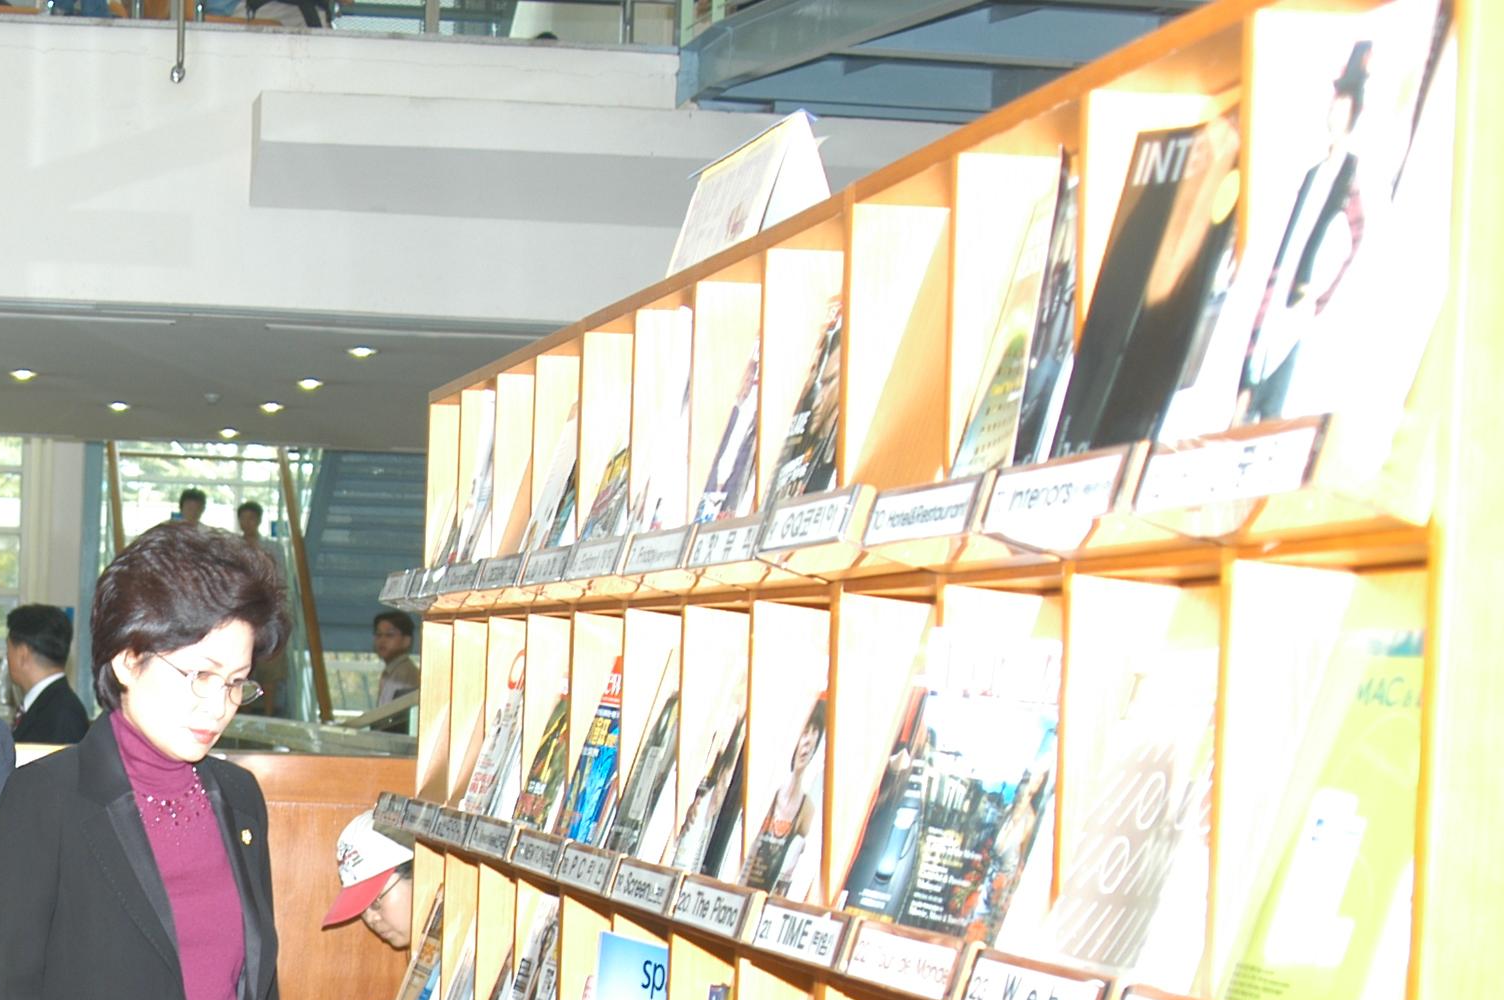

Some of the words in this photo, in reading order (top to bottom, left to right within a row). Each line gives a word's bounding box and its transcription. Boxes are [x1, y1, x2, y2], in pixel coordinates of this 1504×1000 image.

[693, 890, 710, 914] The
[712, 896, 738, 929] Piano
[759, 919, 772, 940] 21
[776, 914, 813, 950] TIME
[641, 959, 667, 1000] sp
